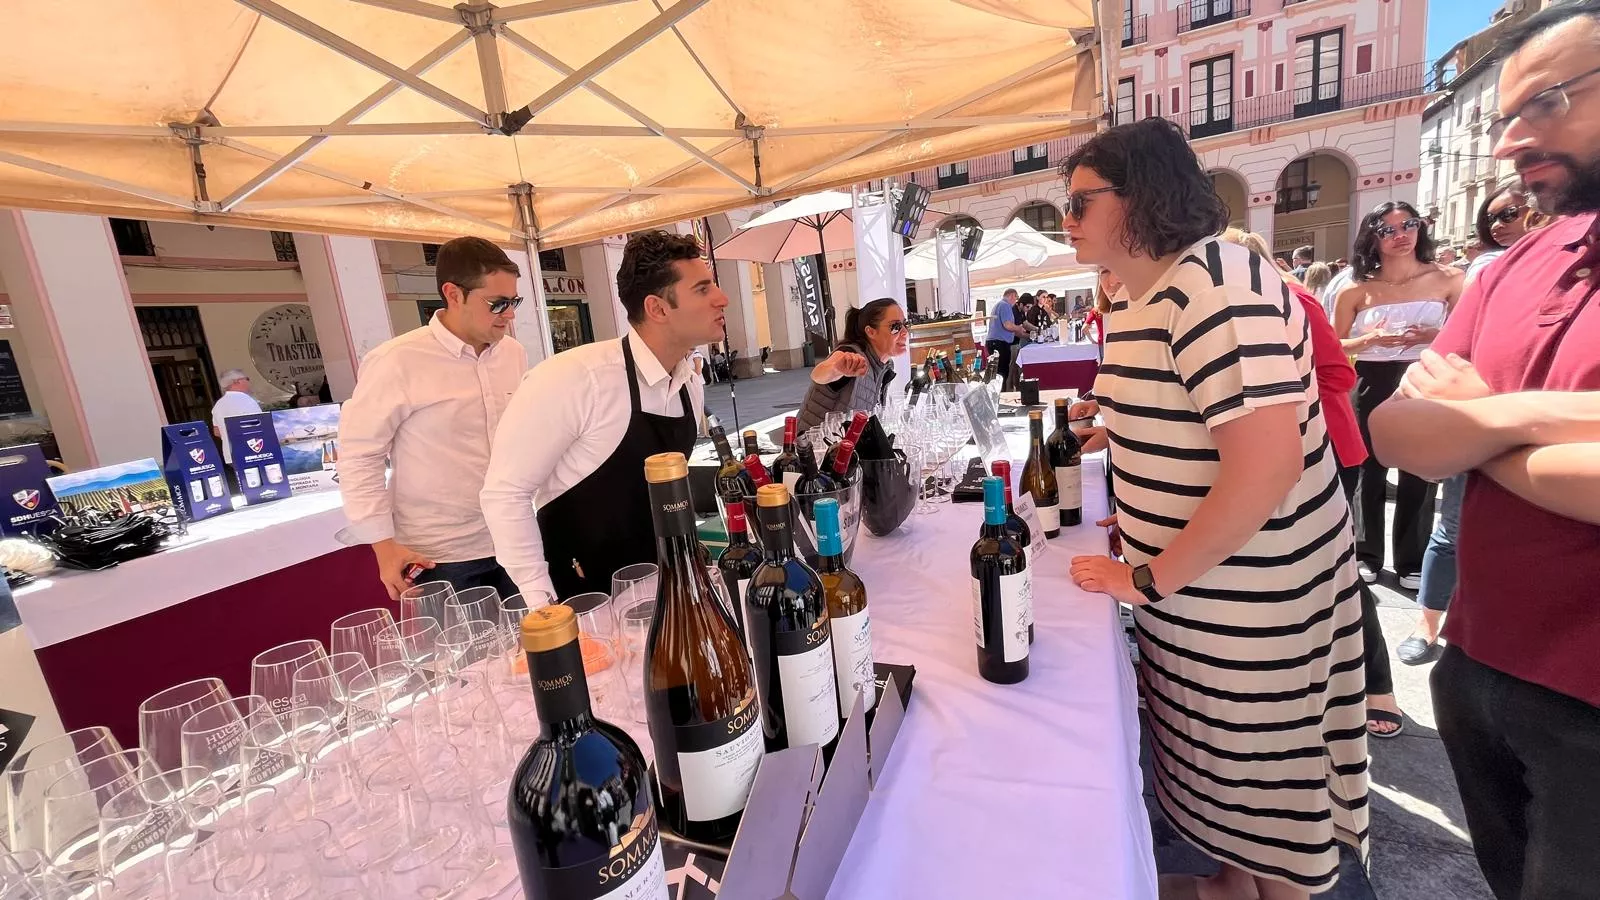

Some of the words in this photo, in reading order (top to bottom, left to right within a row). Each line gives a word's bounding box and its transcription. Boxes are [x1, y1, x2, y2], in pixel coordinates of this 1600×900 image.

[290, 324, 308, 343] LA
[662, 500, 689, 512] SOMMOS
[10, 508, 58, 523] SDHUESCA
[537, 673, 573, 689] SOMMOS
